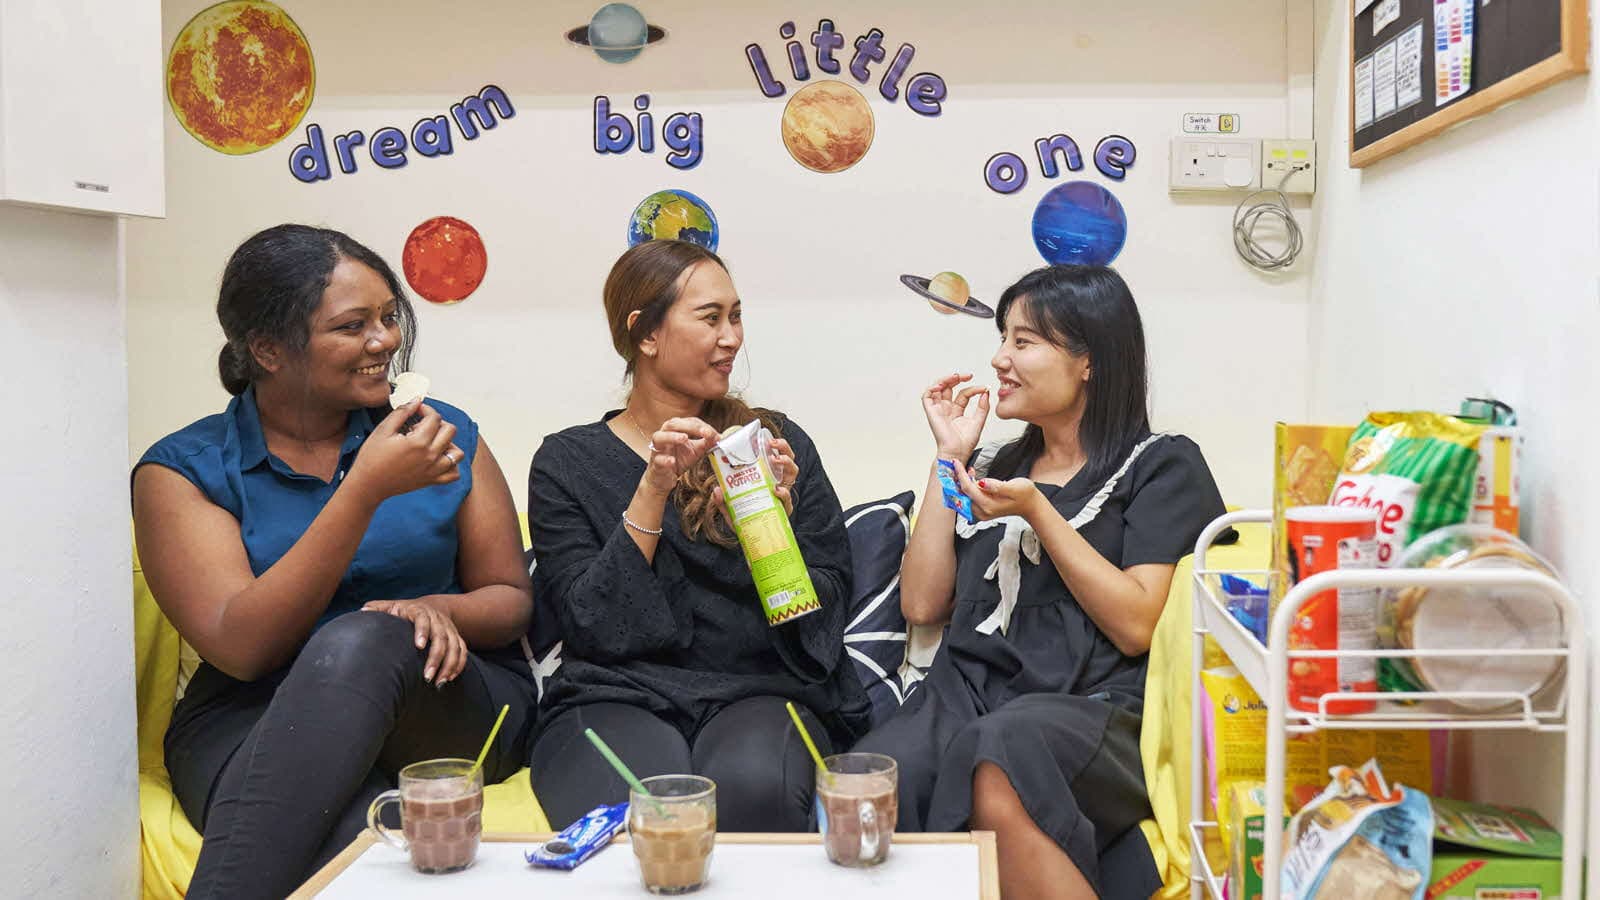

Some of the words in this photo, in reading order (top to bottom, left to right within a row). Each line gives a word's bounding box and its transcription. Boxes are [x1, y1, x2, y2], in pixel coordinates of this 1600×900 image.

[289, 84, 515, 184] dream
[593, 94, 704, 170] big
[745, 19, 948, 116] little
[984, 133, 1137, 194] one
[1189, 115, 1211, 123] Switch
